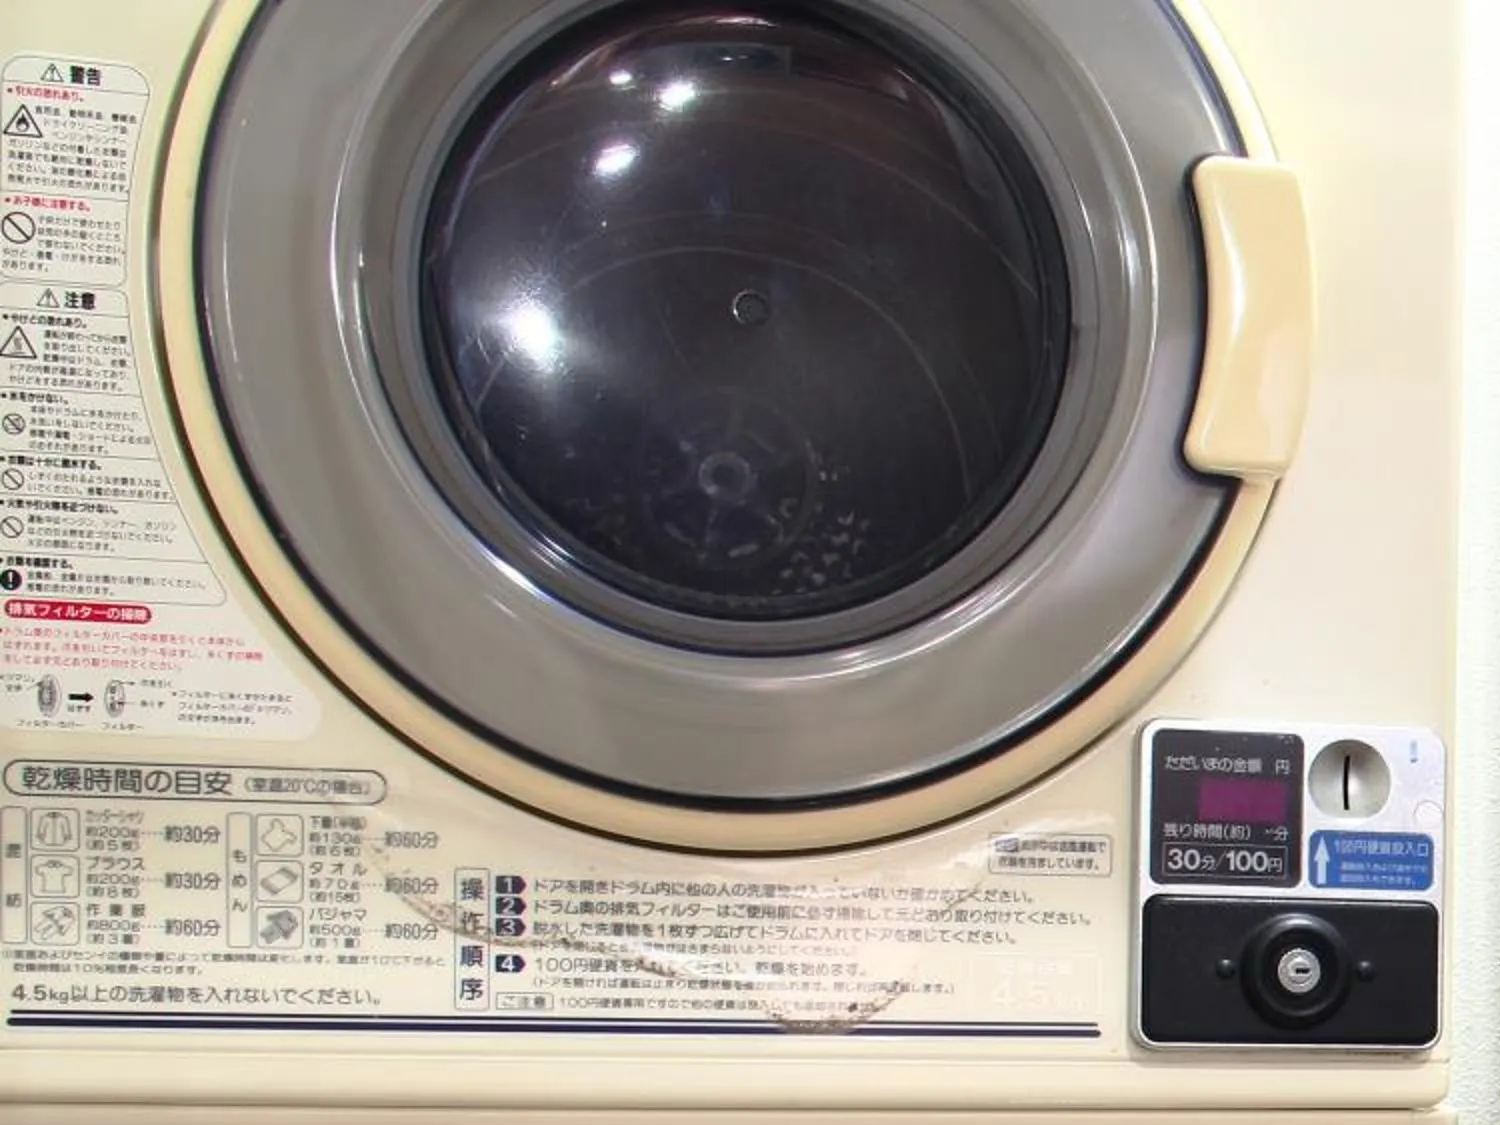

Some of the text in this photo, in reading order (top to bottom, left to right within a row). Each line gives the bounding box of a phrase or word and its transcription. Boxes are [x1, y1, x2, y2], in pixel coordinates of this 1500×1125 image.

[70, 65, 101, 86] 警告
[64, 290, 95, 310] 注意
[8, 601, 149, 622] 排気フィルターの掃除
[1164, 755, 1290, 775] ただいまの金額 円
[22, 766, 232, 795] 乾燥時間の目安
[164, 825, 221, 843] 約30分
[384, 831, 439, 849] 約60分
[1163, 823, 1289, 841] 残り時間(約) 分
[86, 856, 146, 870] ブラウス
[309, 862, 368, 876] タオル
[1167, 848, 1283, 873] 30分/100円
[164, 871, 221, 890] 約30分
[384, 877, 439, 894] 約60分
[309, 908, 367, 921] パジャマ
[165, 919, 221, 936] 約60分
[384, 923, 439, 940] 約60分
[12, 983, 381, 1005] 4.5kg以上の洗濯物を入れないでください。
